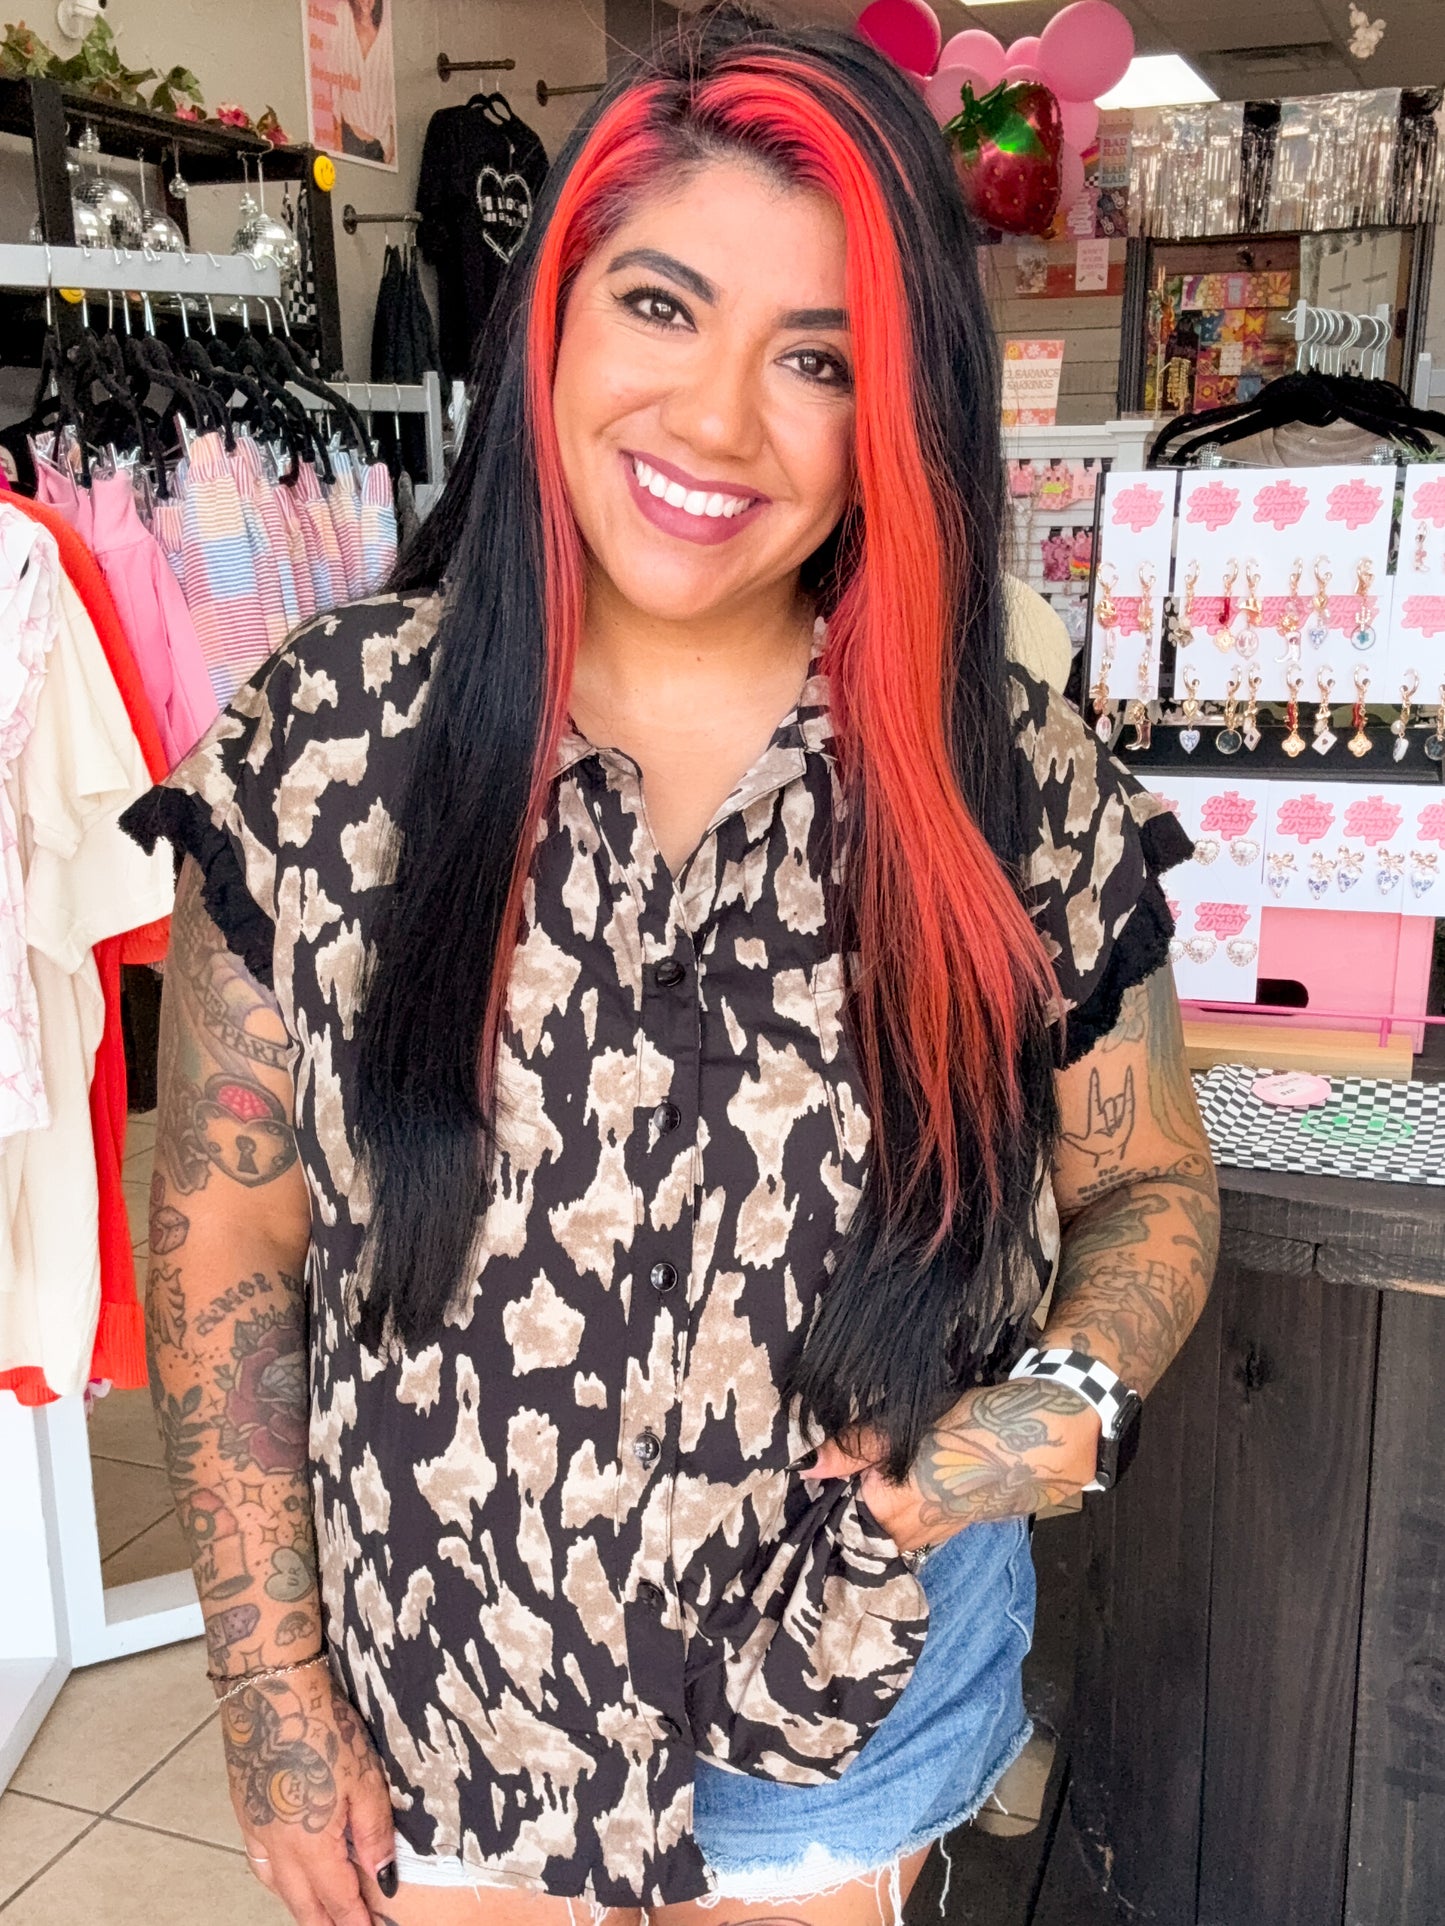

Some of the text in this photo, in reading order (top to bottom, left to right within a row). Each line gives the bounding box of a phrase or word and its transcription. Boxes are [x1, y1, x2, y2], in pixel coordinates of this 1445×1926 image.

[1003, 367, 1060, 379] CLEARANCE
[1007, 380, 1054, 390] EARRINGS
[1202, 797, 1257, 819] Black
[1277, 799, 1335, 822] Black
[1344, 801, 1403, 823] Black
